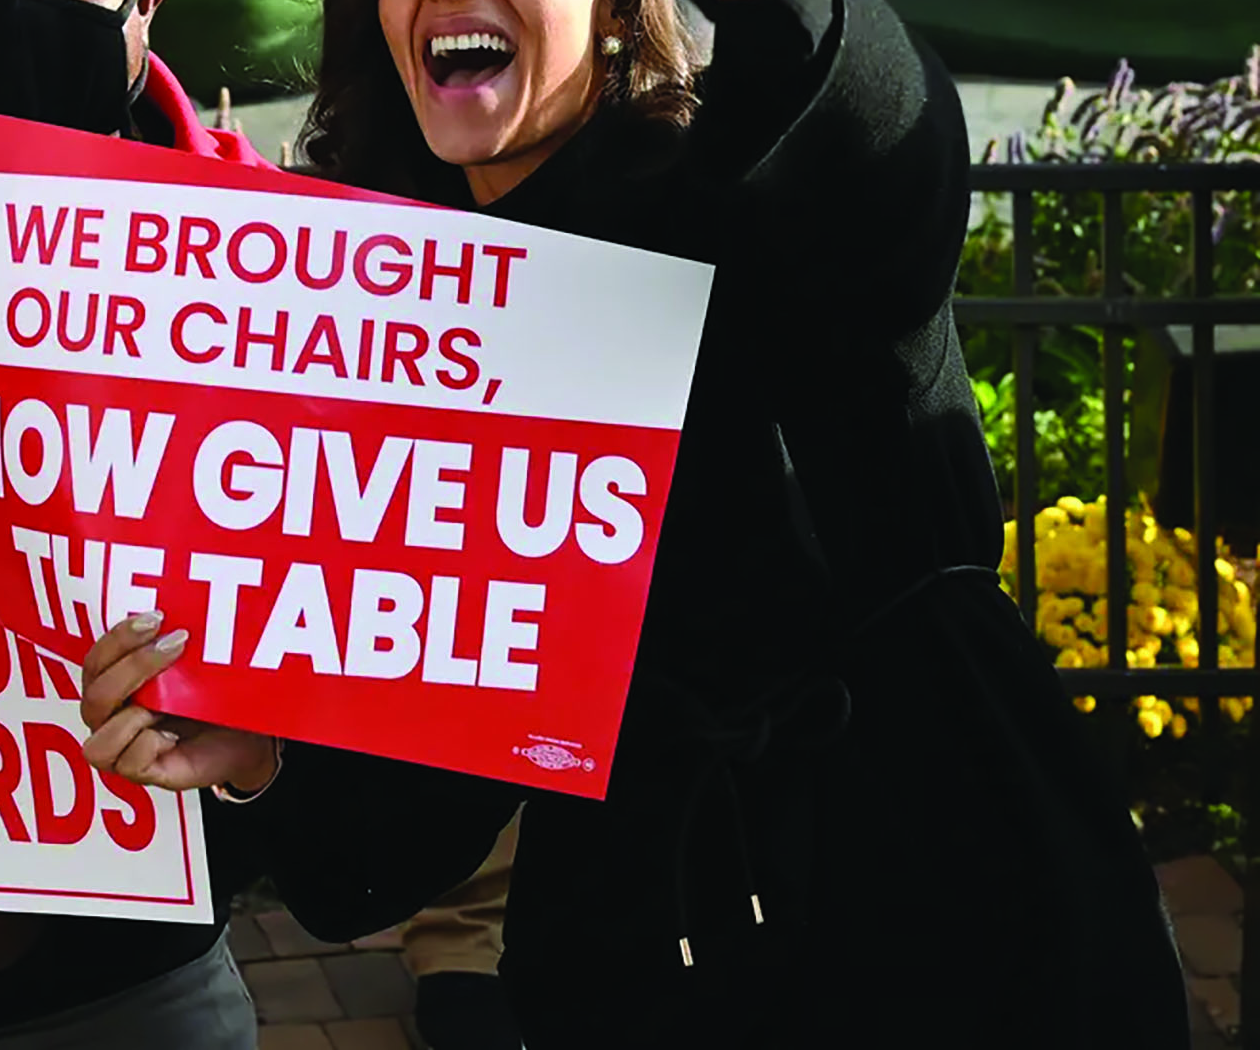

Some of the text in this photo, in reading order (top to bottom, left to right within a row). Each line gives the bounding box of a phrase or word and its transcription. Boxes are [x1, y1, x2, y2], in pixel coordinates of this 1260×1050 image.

[5, 202, 527, 308] WE BROUGHT
[6, 288, 503, 405] OUR CHAIRS,
[193, 420, 473, 551] GIVE
[495, 450, 649, 565] US
[11, 524, 546, 692] THE TABLE
